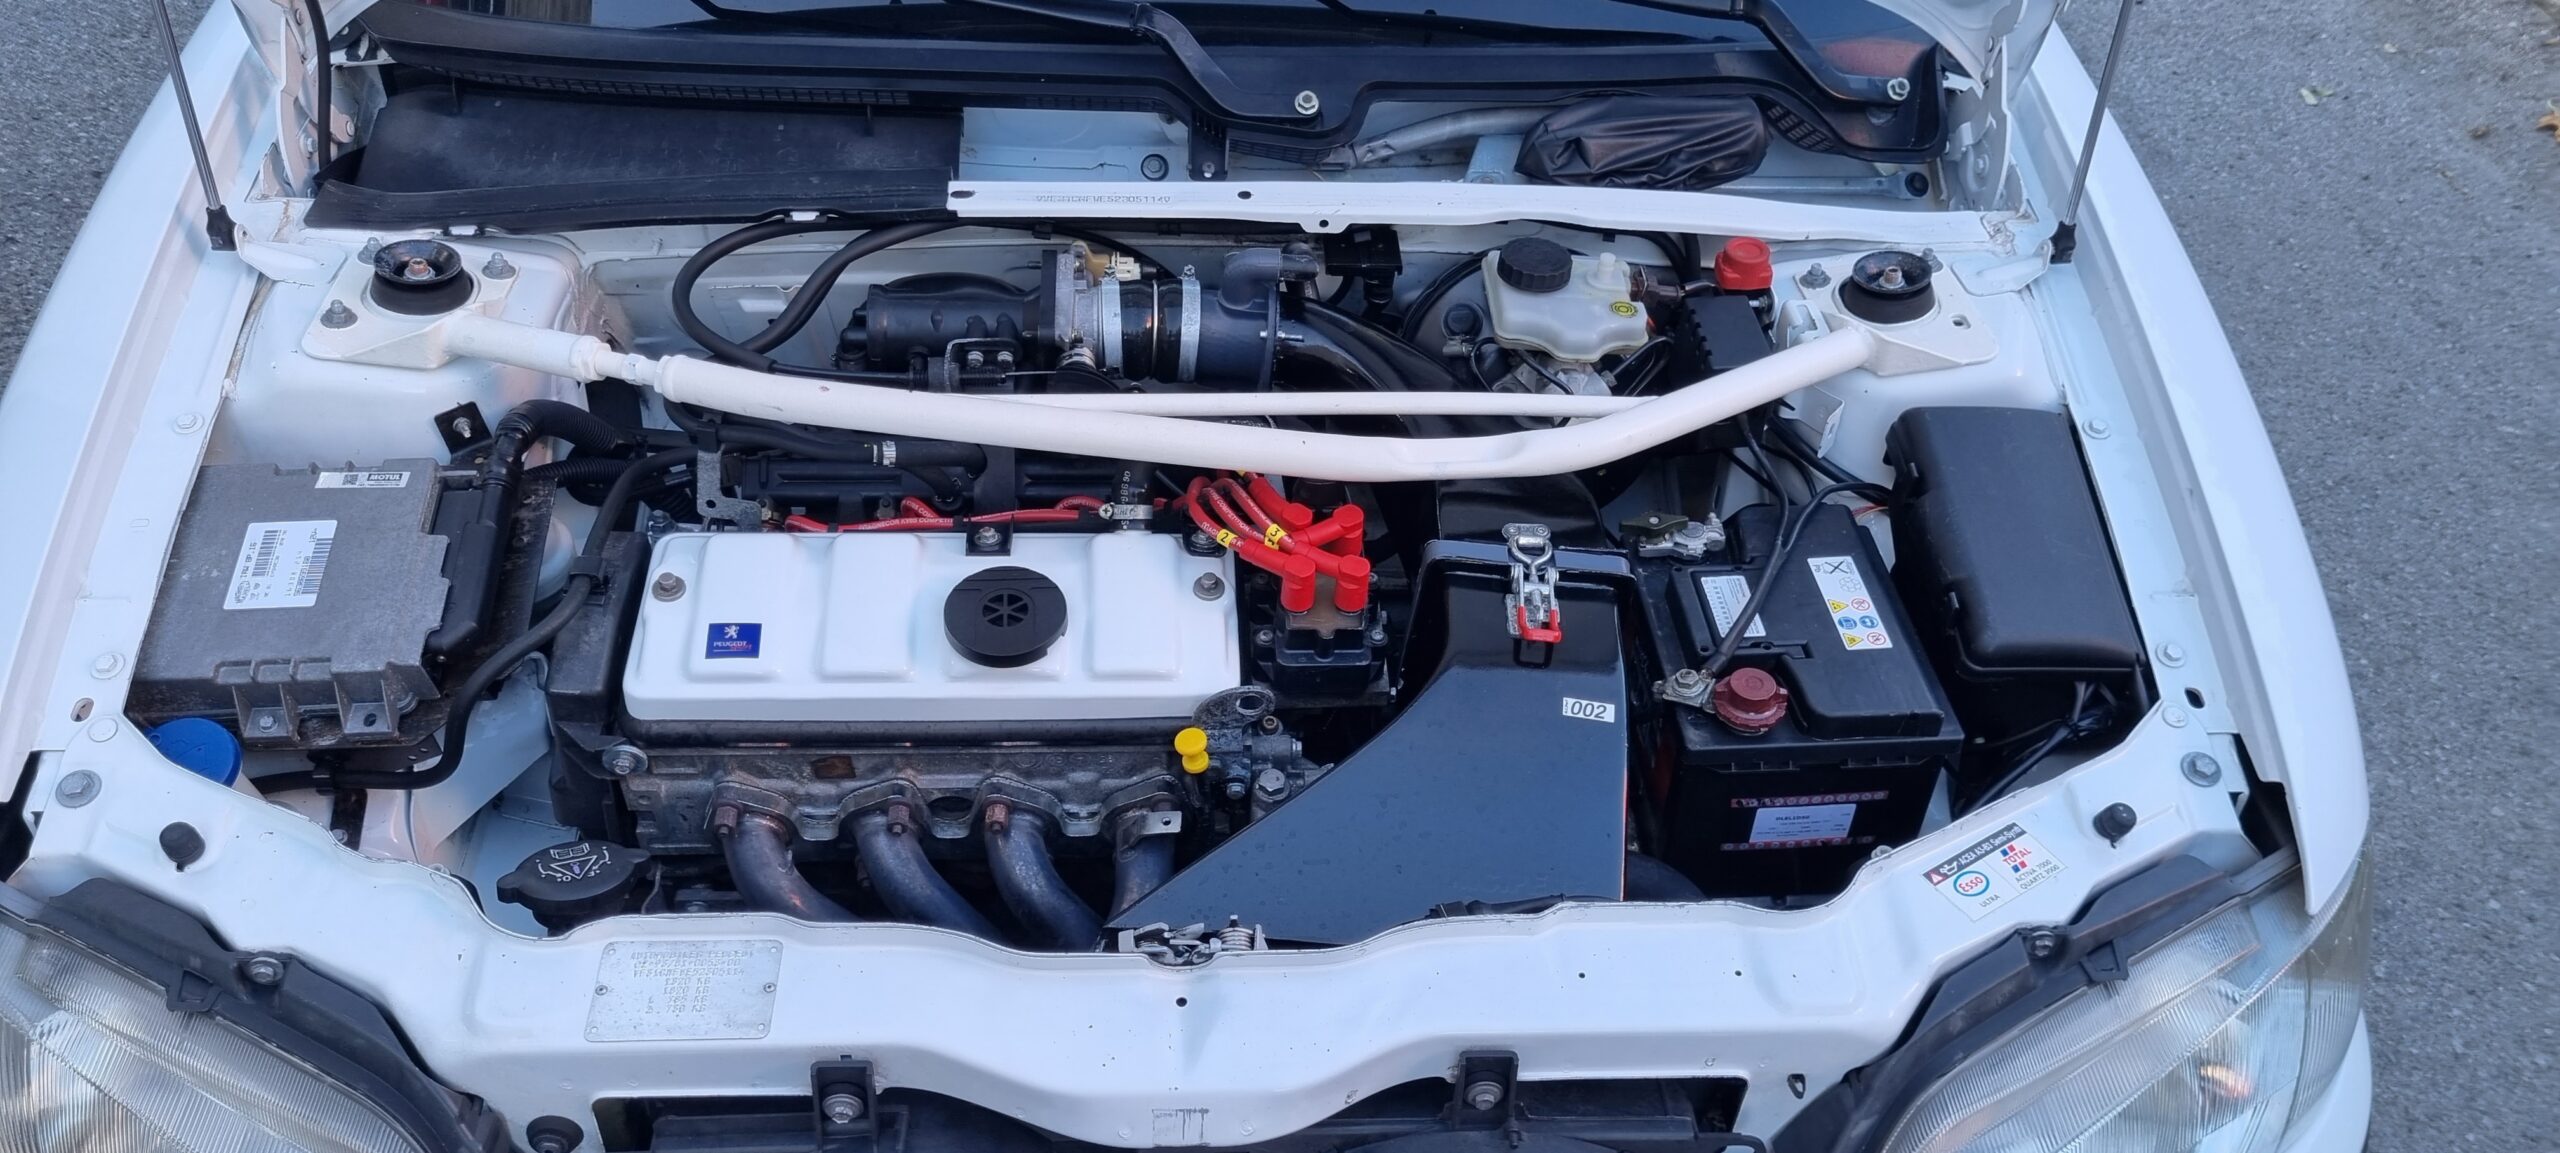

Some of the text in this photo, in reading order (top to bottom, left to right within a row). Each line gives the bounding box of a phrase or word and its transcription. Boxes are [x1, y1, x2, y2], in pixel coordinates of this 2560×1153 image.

[1220, 532, 1228, 543] 2
[1570, 700, 1607, 720] 002
[2002, 847, 2032, 866] TOTAL
[1979, 894, 2001, 908] ULTRA
